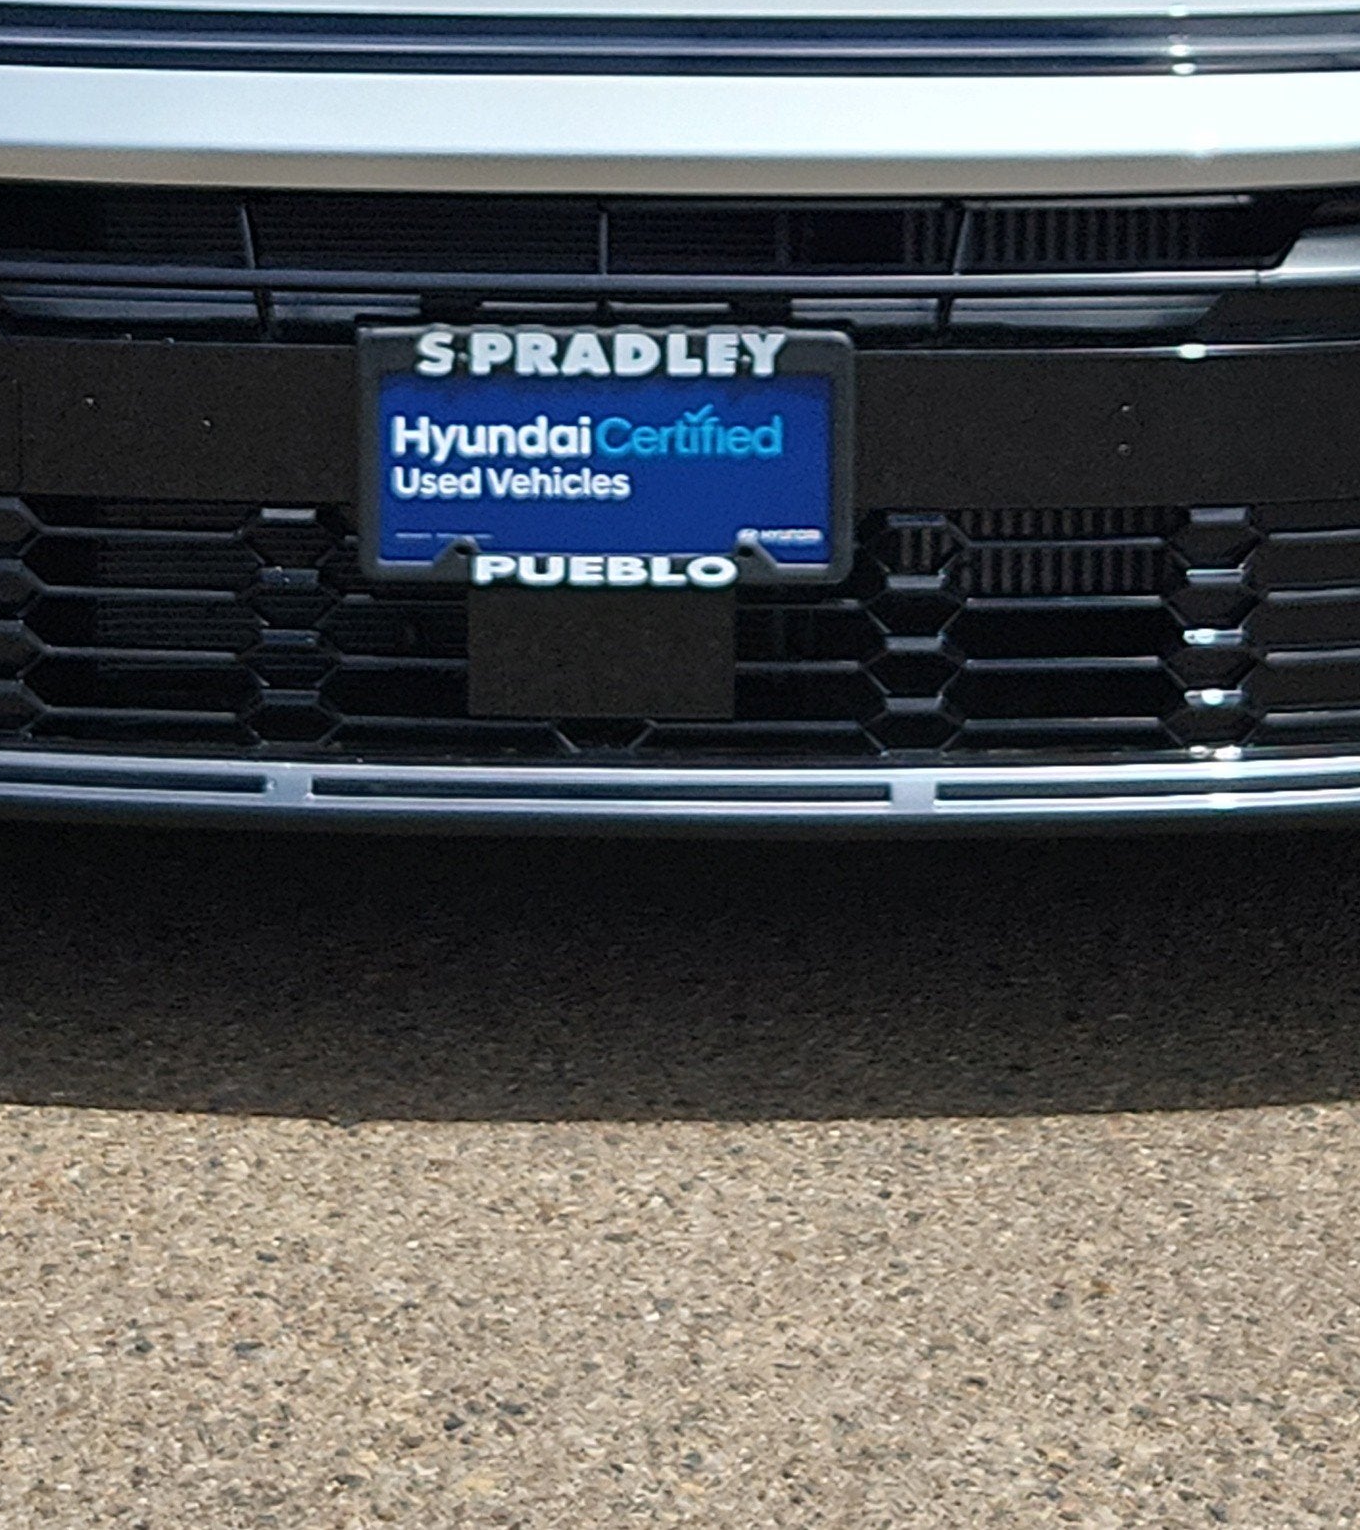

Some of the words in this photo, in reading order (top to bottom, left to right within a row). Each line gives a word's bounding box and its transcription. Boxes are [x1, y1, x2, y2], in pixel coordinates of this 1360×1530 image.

[393, 416, 592, 462] Hyundai
[596, 404, 783, 456] Certified
[393, 468, 482, 497] Used
[488, 467, 630, 498] Vehicles
[473, 556, 738, 586] PUEBLO
